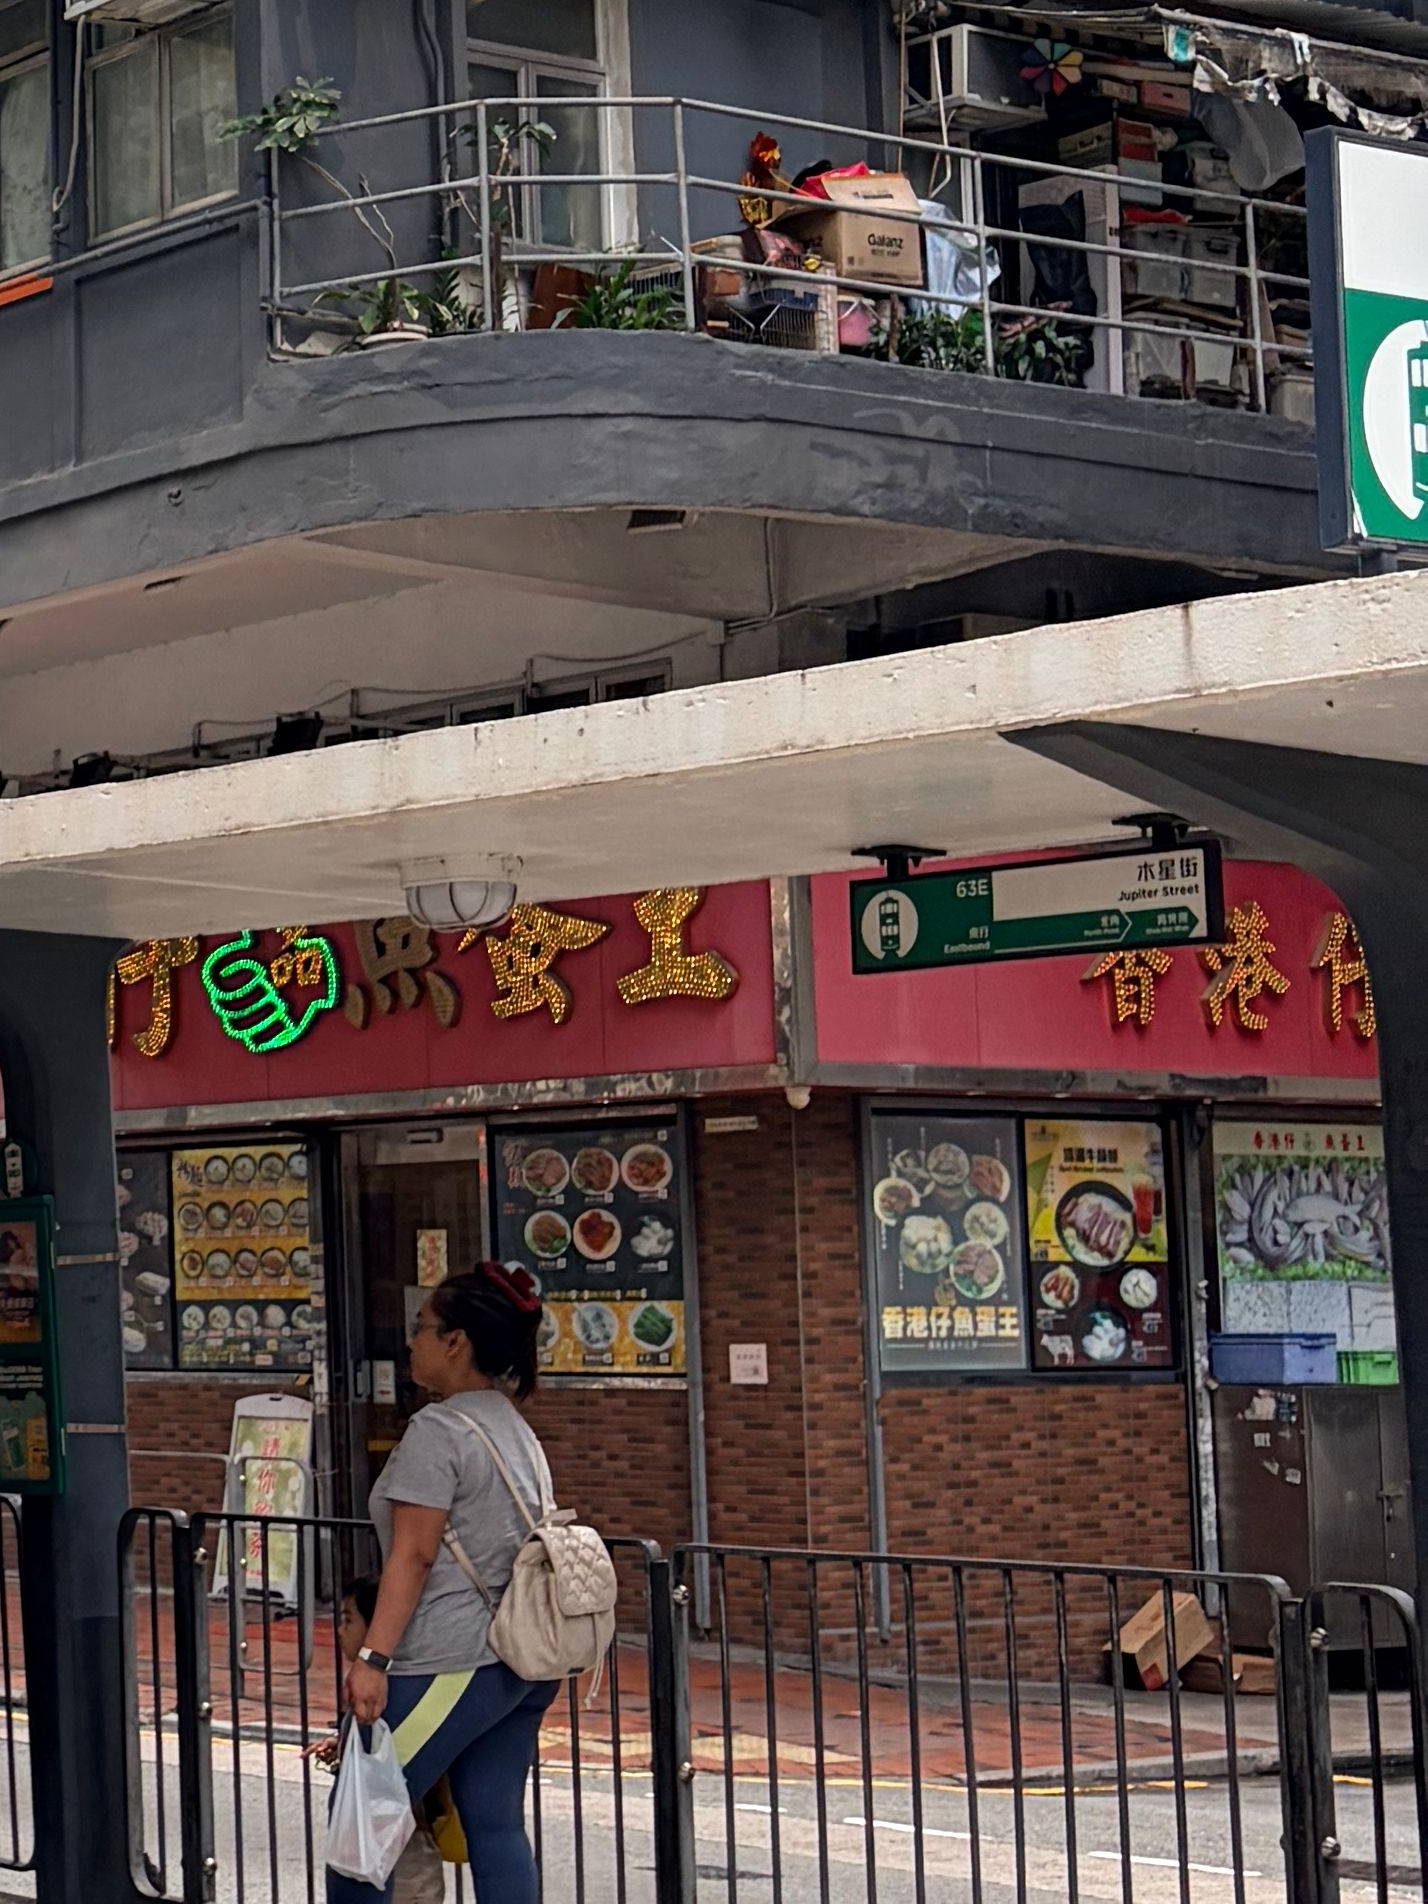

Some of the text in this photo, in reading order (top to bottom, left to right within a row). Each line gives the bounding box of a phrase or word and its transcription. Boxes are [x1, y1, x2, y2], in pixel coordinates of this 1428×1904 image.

[867, 233, 904, 250] Galanz
[1137, 856, 1198, 882] 木星街
[955, 879, 989, 898] 63E
[1117, 883, 1200, 903] Jupiter Street
[882, 1306, 1021, 1339] 香港仔魚蛋王
